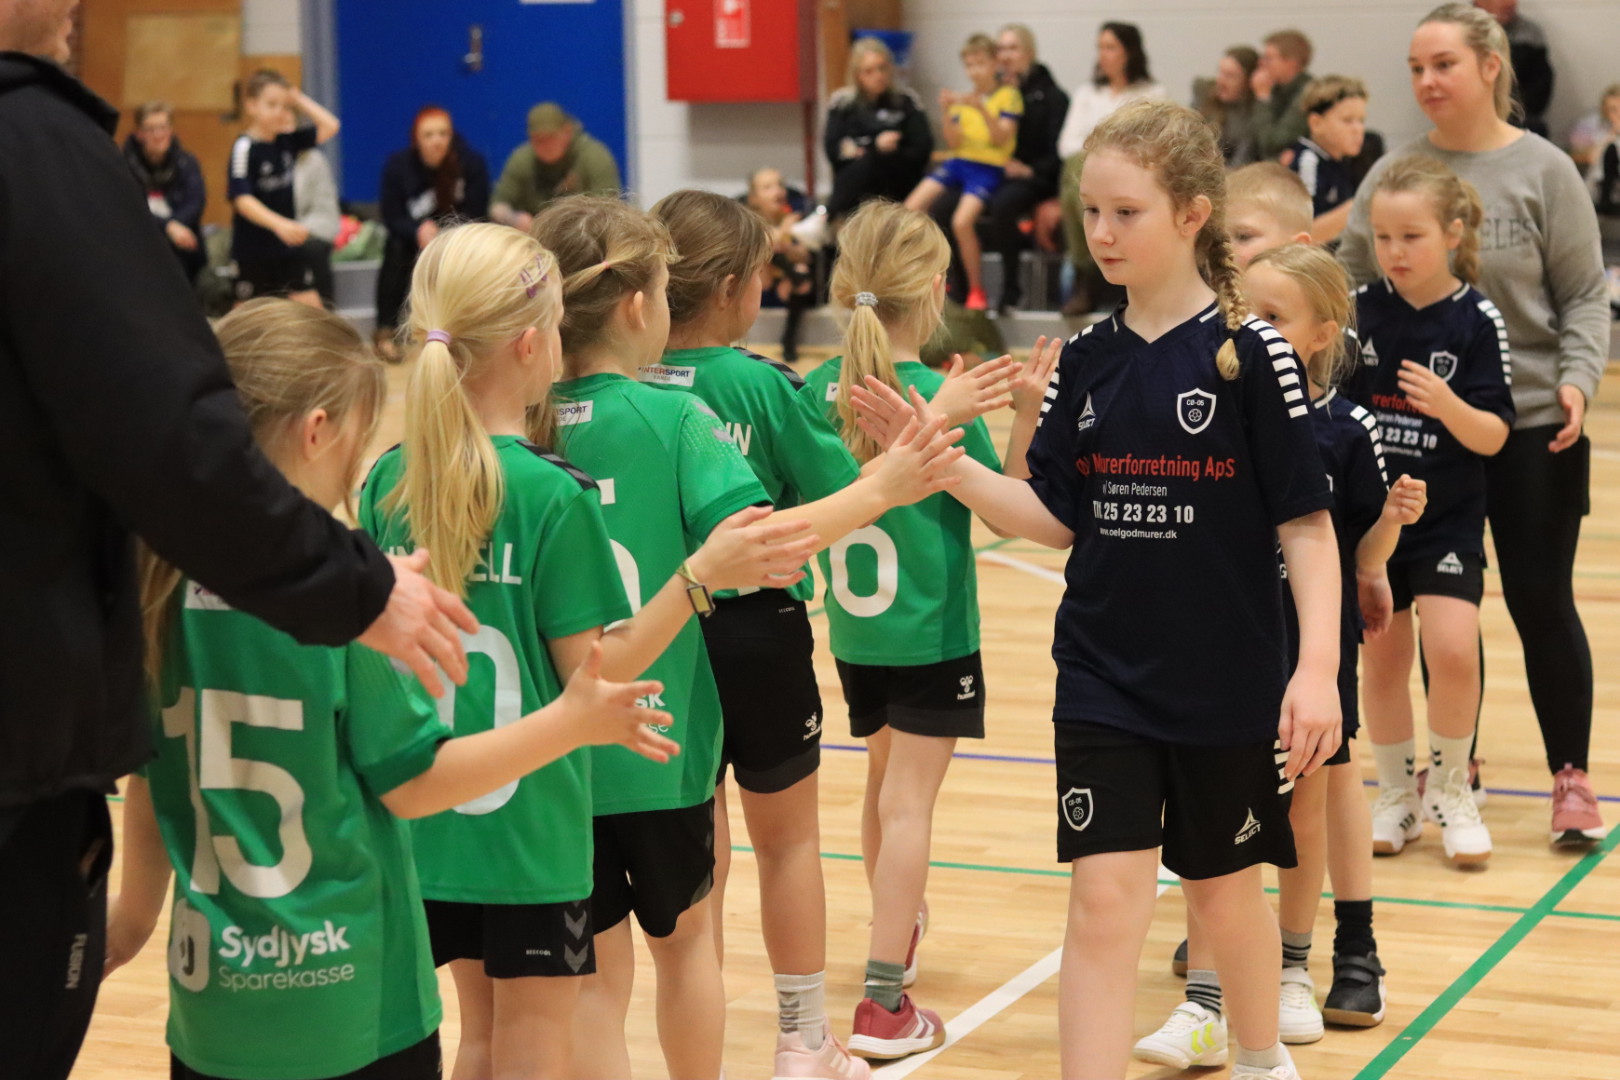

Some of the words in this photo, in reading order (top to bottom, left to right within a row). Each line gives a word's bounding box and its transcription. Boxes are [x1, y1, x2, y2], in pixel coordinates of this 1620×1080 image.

[1204, 456, 1236, 481] ApS
[1131, 482, 1168, 497] Pedersen
[1103, 501, 1119, 521] 25
[1122, 503, 1143, 522] 23
[1146, 504, 1168, 523] 23
[1173, 505, 1195, 524] 10
[161, 686, 313, 899] 15
[218, 919, 351, 968] Sydjysk
[218, 963, 355, 993] Sparekasse
